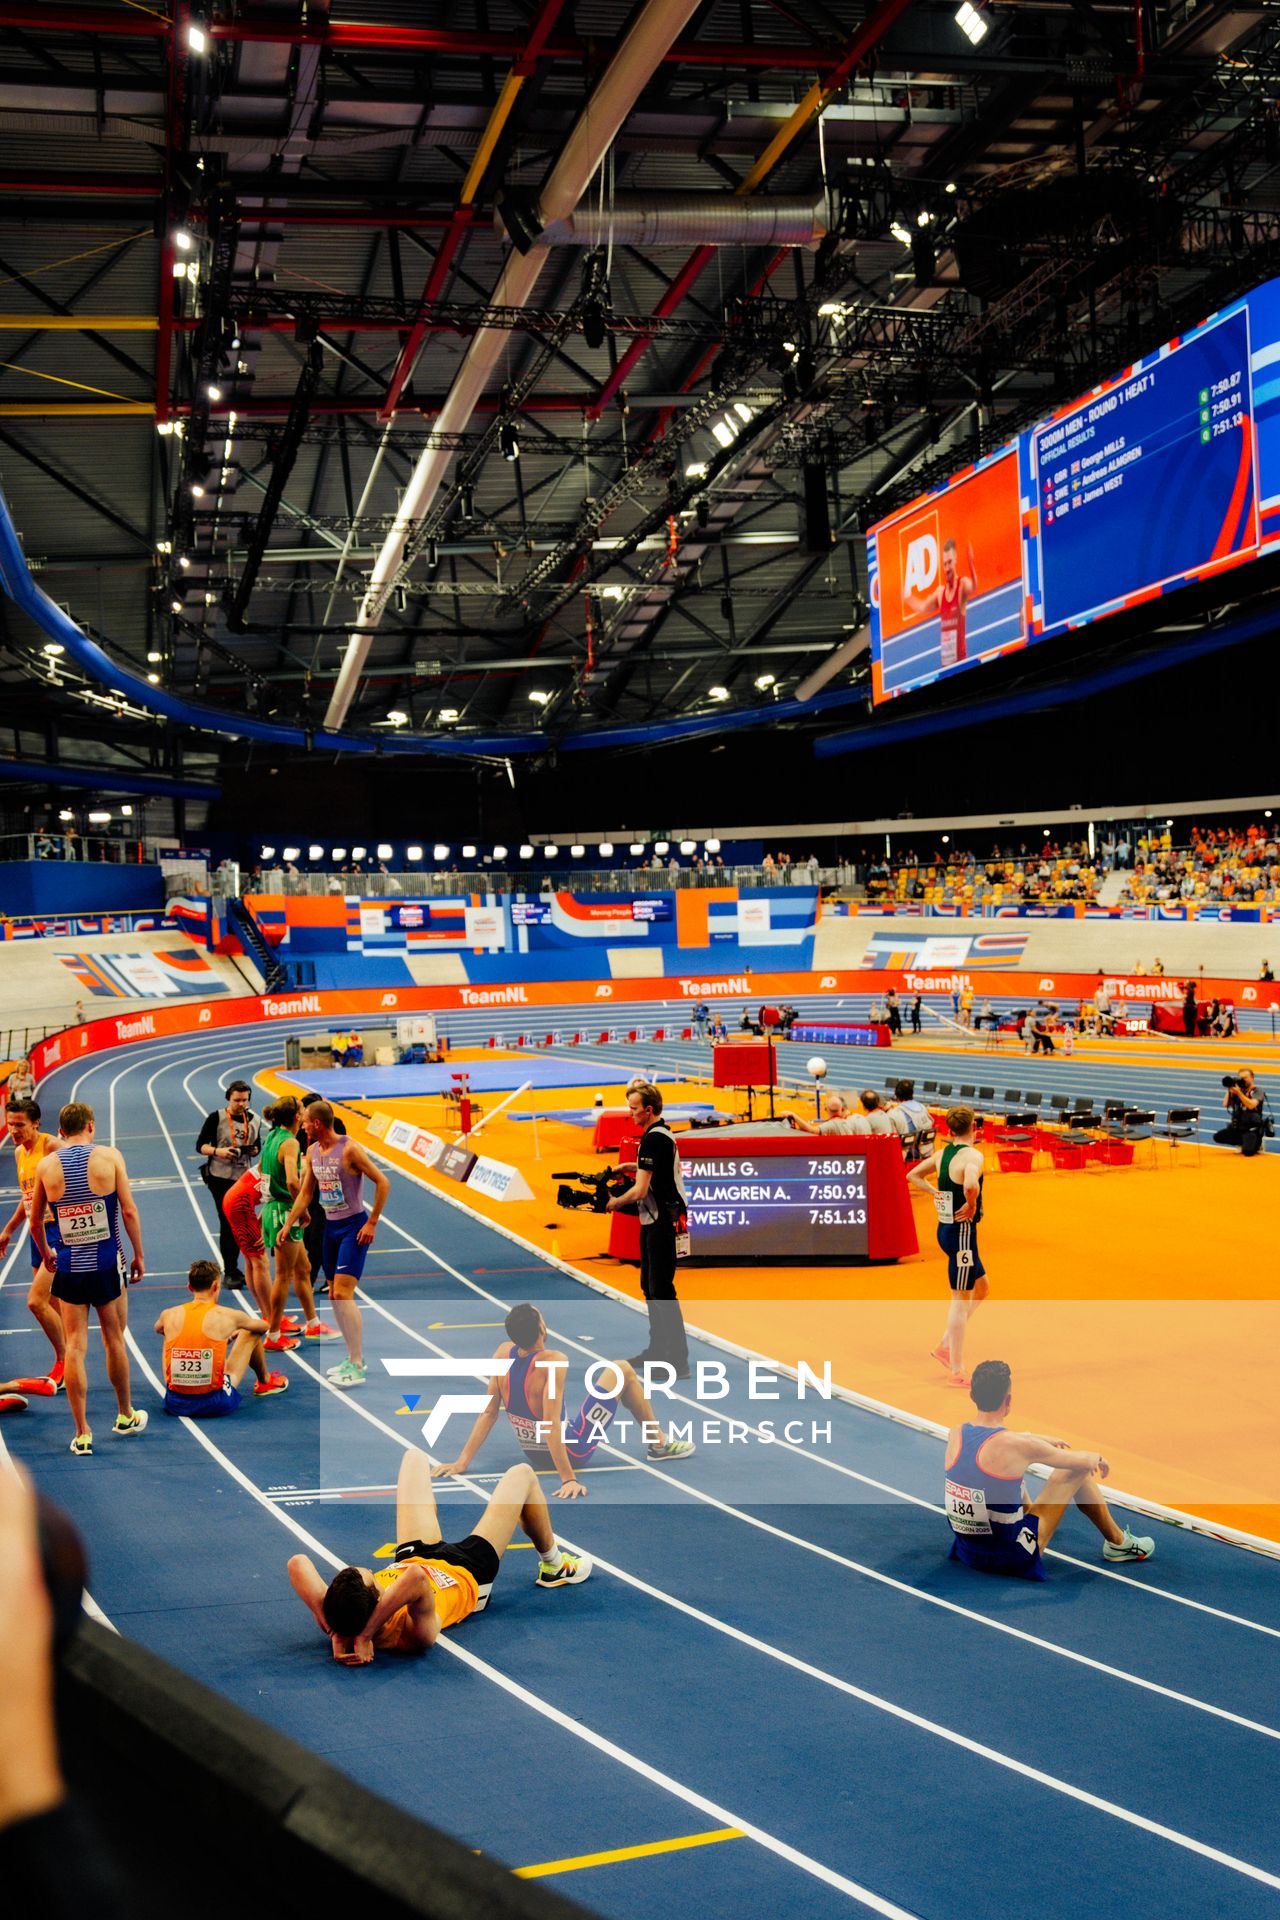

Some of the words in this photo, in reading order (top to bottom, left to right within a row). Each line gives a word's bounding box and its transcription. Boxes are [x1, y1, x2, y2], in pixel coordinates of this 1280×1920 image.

[1040, 427, 1065, 451] 3000M
[1065, 416, 1083, 437] MEN
[1088, 396, 1118, 423] ROUND
[1118, 391, 1124, 404] 1
[1125, 376, 1149, 401] HEAT
[1149, 373, 1155, 386] 1
[1054, 468, 1068, 484] GBR
[1081, 450, 1104, 470] George
[1103, 436, 1125, 457] MILLS
[1211, 371, 1241, 397] 7:50.87
[1040, 443, 1067, 466] OFFICIAL
[1067, 426, 1096, 450] RESULTS
[1054, 485, 1069, 501] SWE
[1082, 466, 1108, 487] Andreas
[1107, 445, 1142, 473] ALMGREN
[1211, 392, 1242, 417] 7:50.91
[1055, 502, 1069, 518] GBR
[1083, 486, 1104, 504] James
[1103, 473, 1123, 493] WEST
[1212, 411, 1243, 437] 7:51.13
[678, 979, 751, 996] TeamNL
[903, 974, 974, 991] TeamNL
[1115, 980, 1183, 999] TeamNL
[459, 987, 528, 1005] TeamNL
[261, 996, 321, 1017] TeamNL
[116, 1016, 156, 1040] TeamNL
[693, 1163, 736, 1176] MILLS
[740, 1162, 758, 1176] G.
[808, 1161, 865, 1175] 7:50.87
[693, 1186, 770, 1200] ALMGREN
[774, 1186, 791, 1200] A.
[809, 1185, 866, 1200] 7:50.91
[60, 1205, 92, 1217] SPAR
[693, 1211, 735, 1225] WEST
[738, 1211, 749, 1225] J.
[809, 1209, 866, 1224] 7:51.13
[70, 1215, 96, 1230] 231
[961, 1252, 969, 1264] 6
[173, 1350, 201, 1358] SPAR
[180, 1361, 202, 1371] 323
[515, 1427, 536, 1440] 192
[952, 1499, 975, 1517] 184
